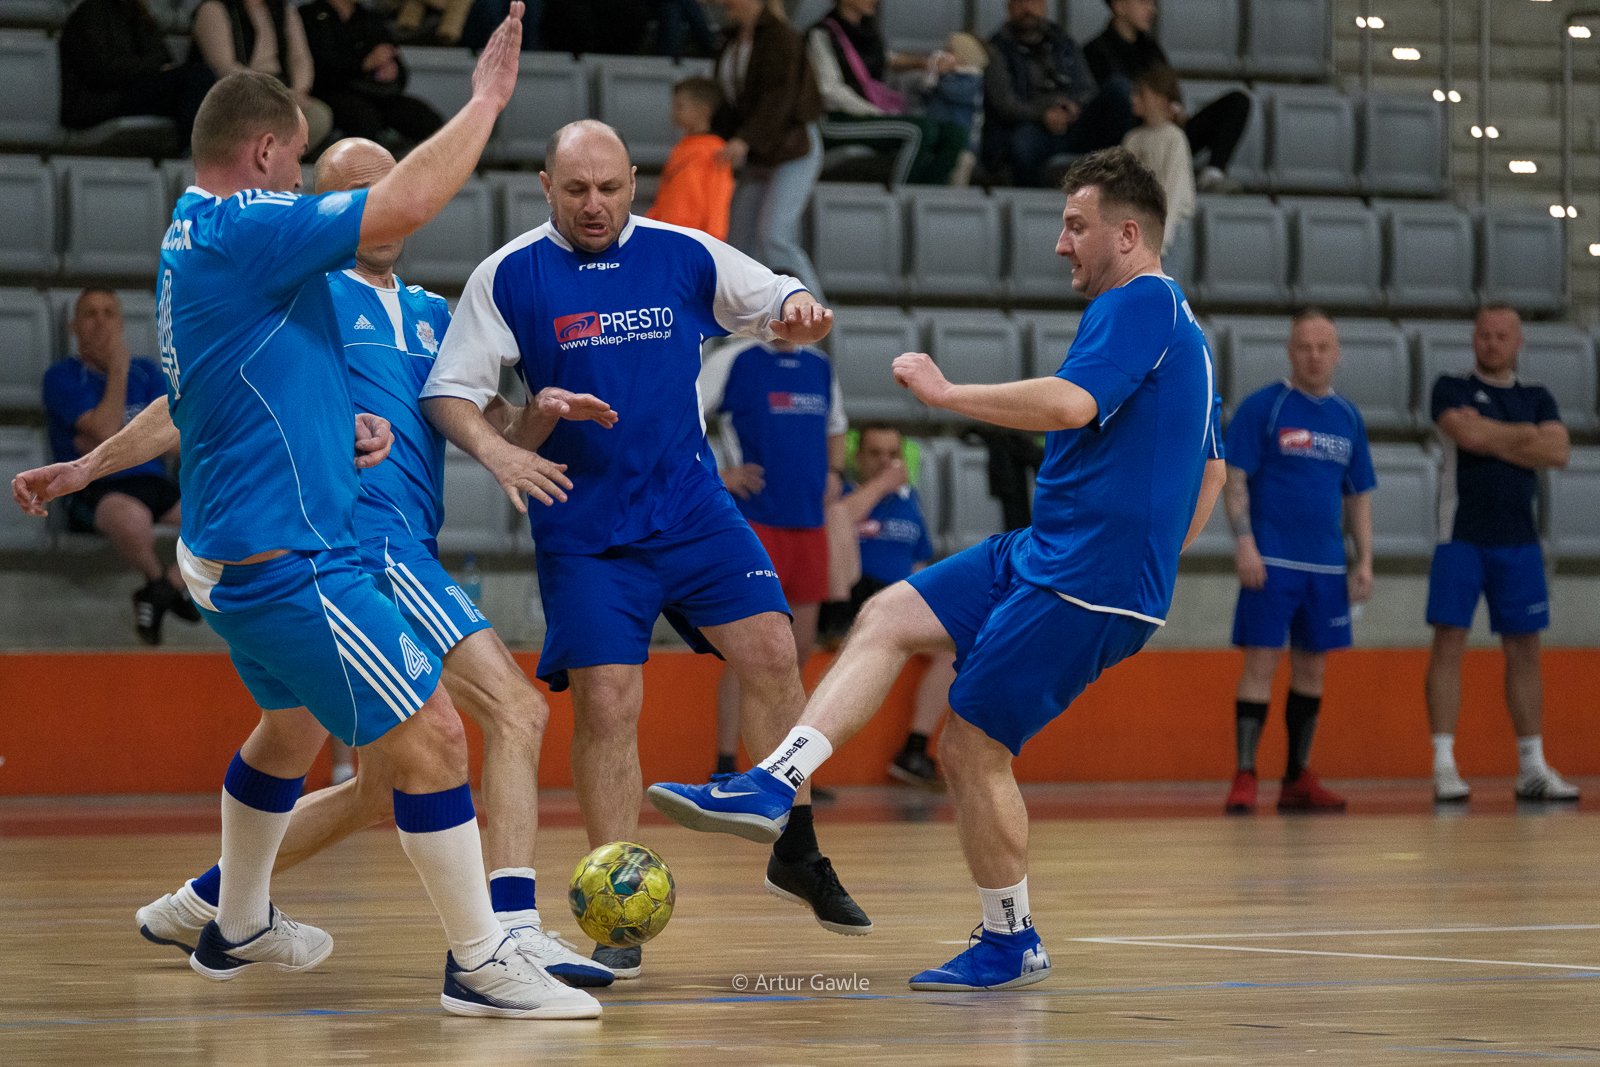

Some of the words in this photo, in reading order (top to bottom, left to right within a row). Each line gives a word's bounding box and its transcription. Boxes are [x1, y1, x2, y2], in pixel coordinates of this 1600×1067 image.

[578, 262, 620, 271] regio
[599, 306, 674, 334] PRESTO
[560, 338, 589, 351] www
[590, 329, 672, 347] Sklep-Presto.pl
[399, 631, 433, 681] 4
